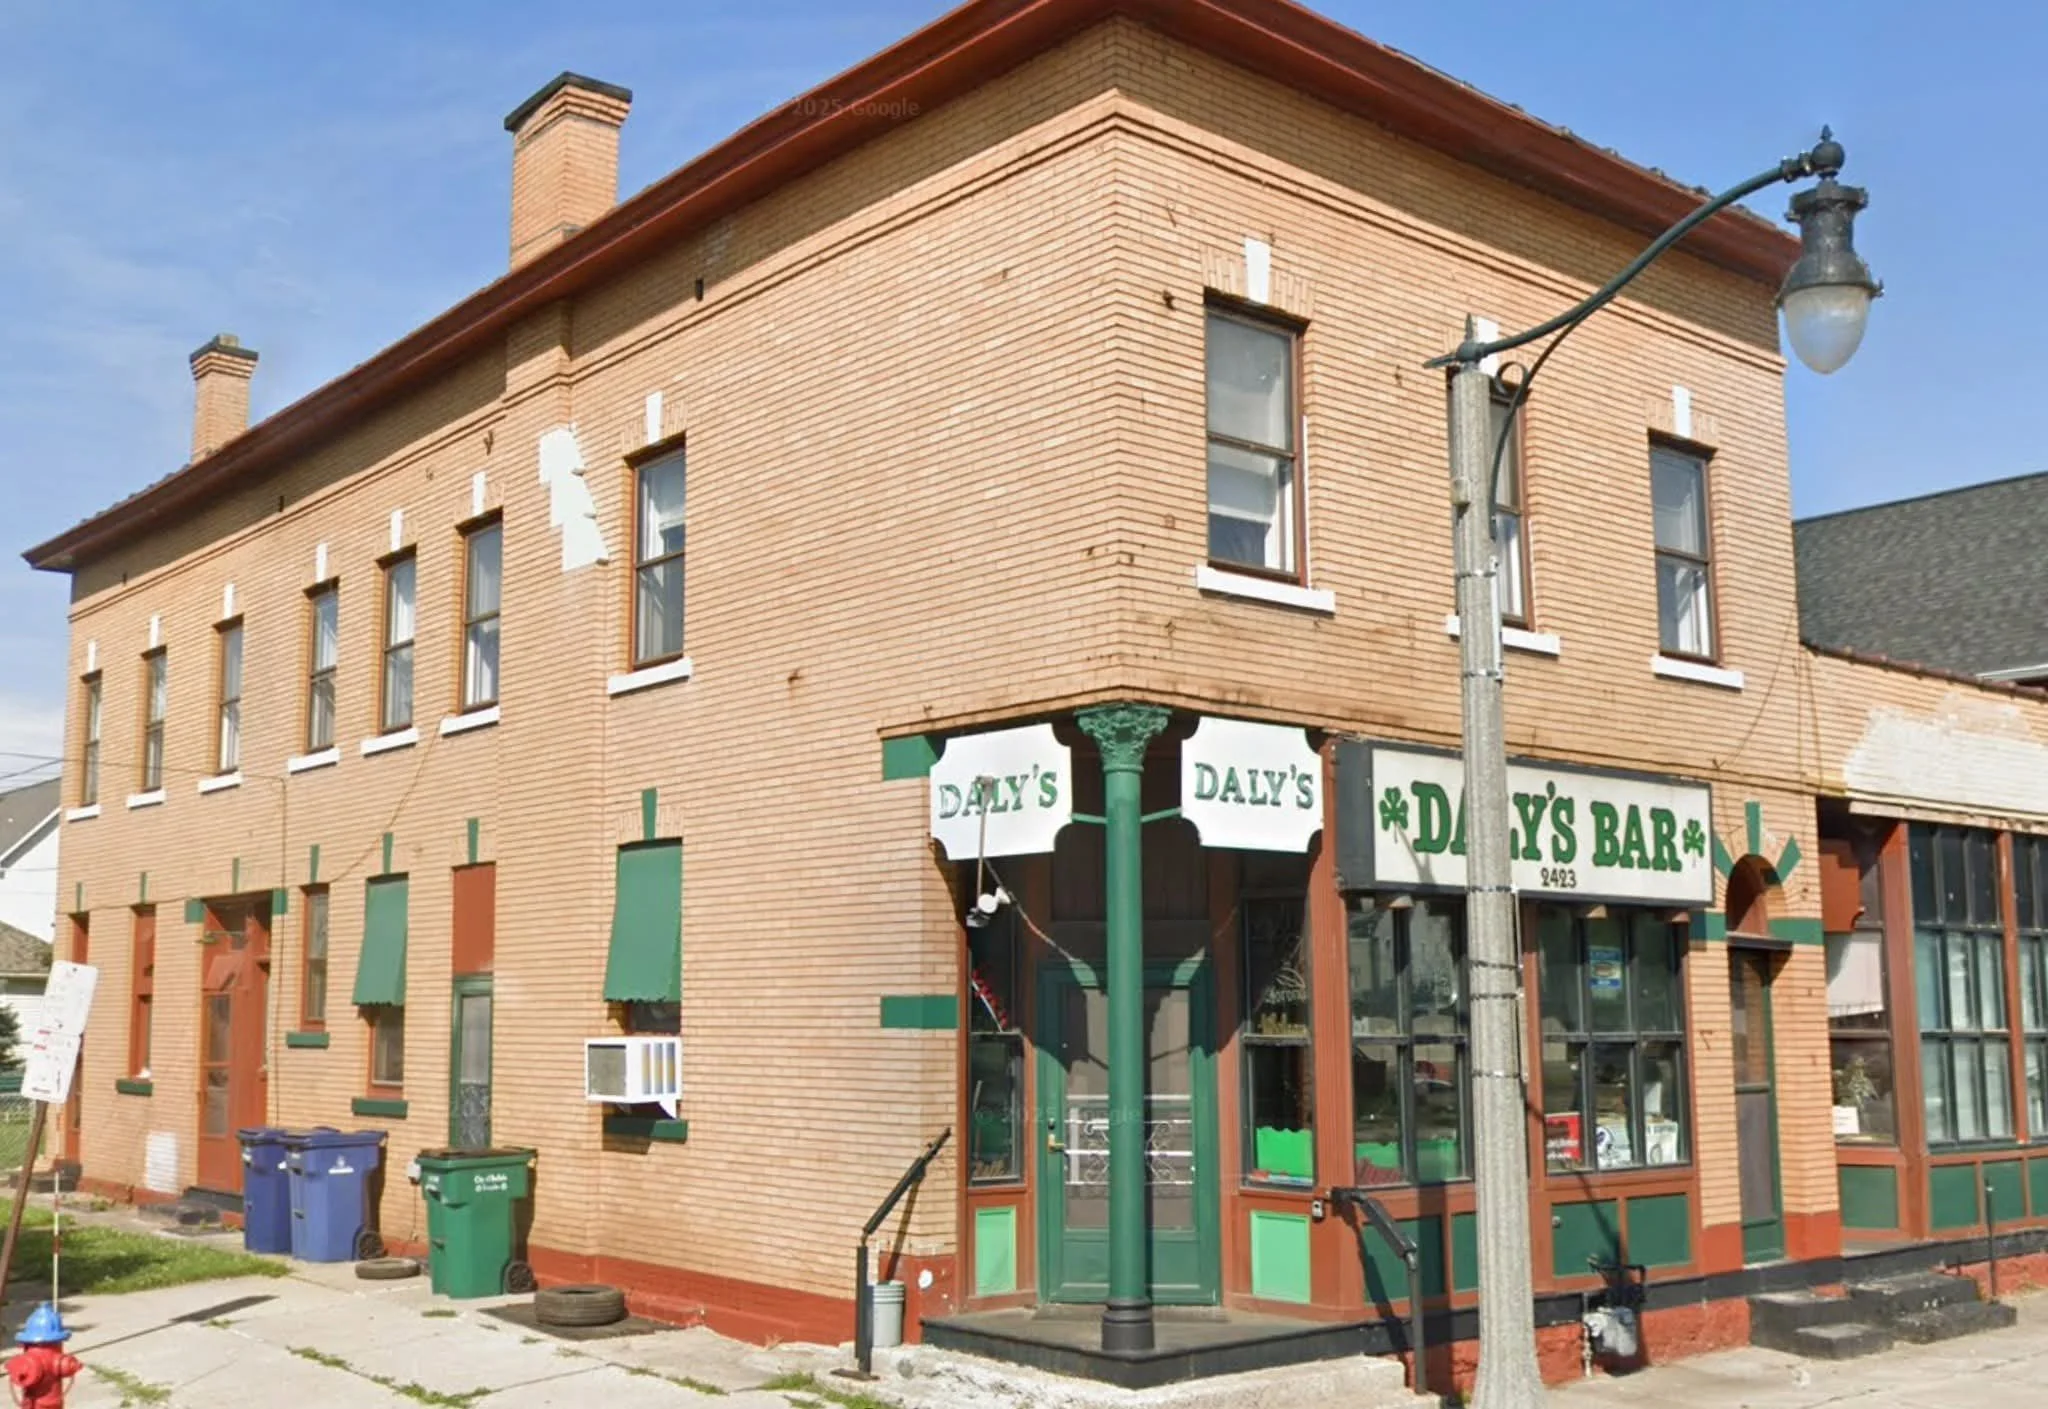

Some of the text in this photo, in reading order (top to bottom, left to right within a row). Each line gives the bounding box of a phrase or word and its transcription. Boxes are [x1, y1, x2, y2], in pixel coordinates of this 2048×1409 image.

[938, 763, 1058, 820] DALY'S
[1194, 762, 1315, 810] DALY'S
[1410, 779, 1683, 873] DY'S BAR
[1541, 867, 1577, 889] 2423
